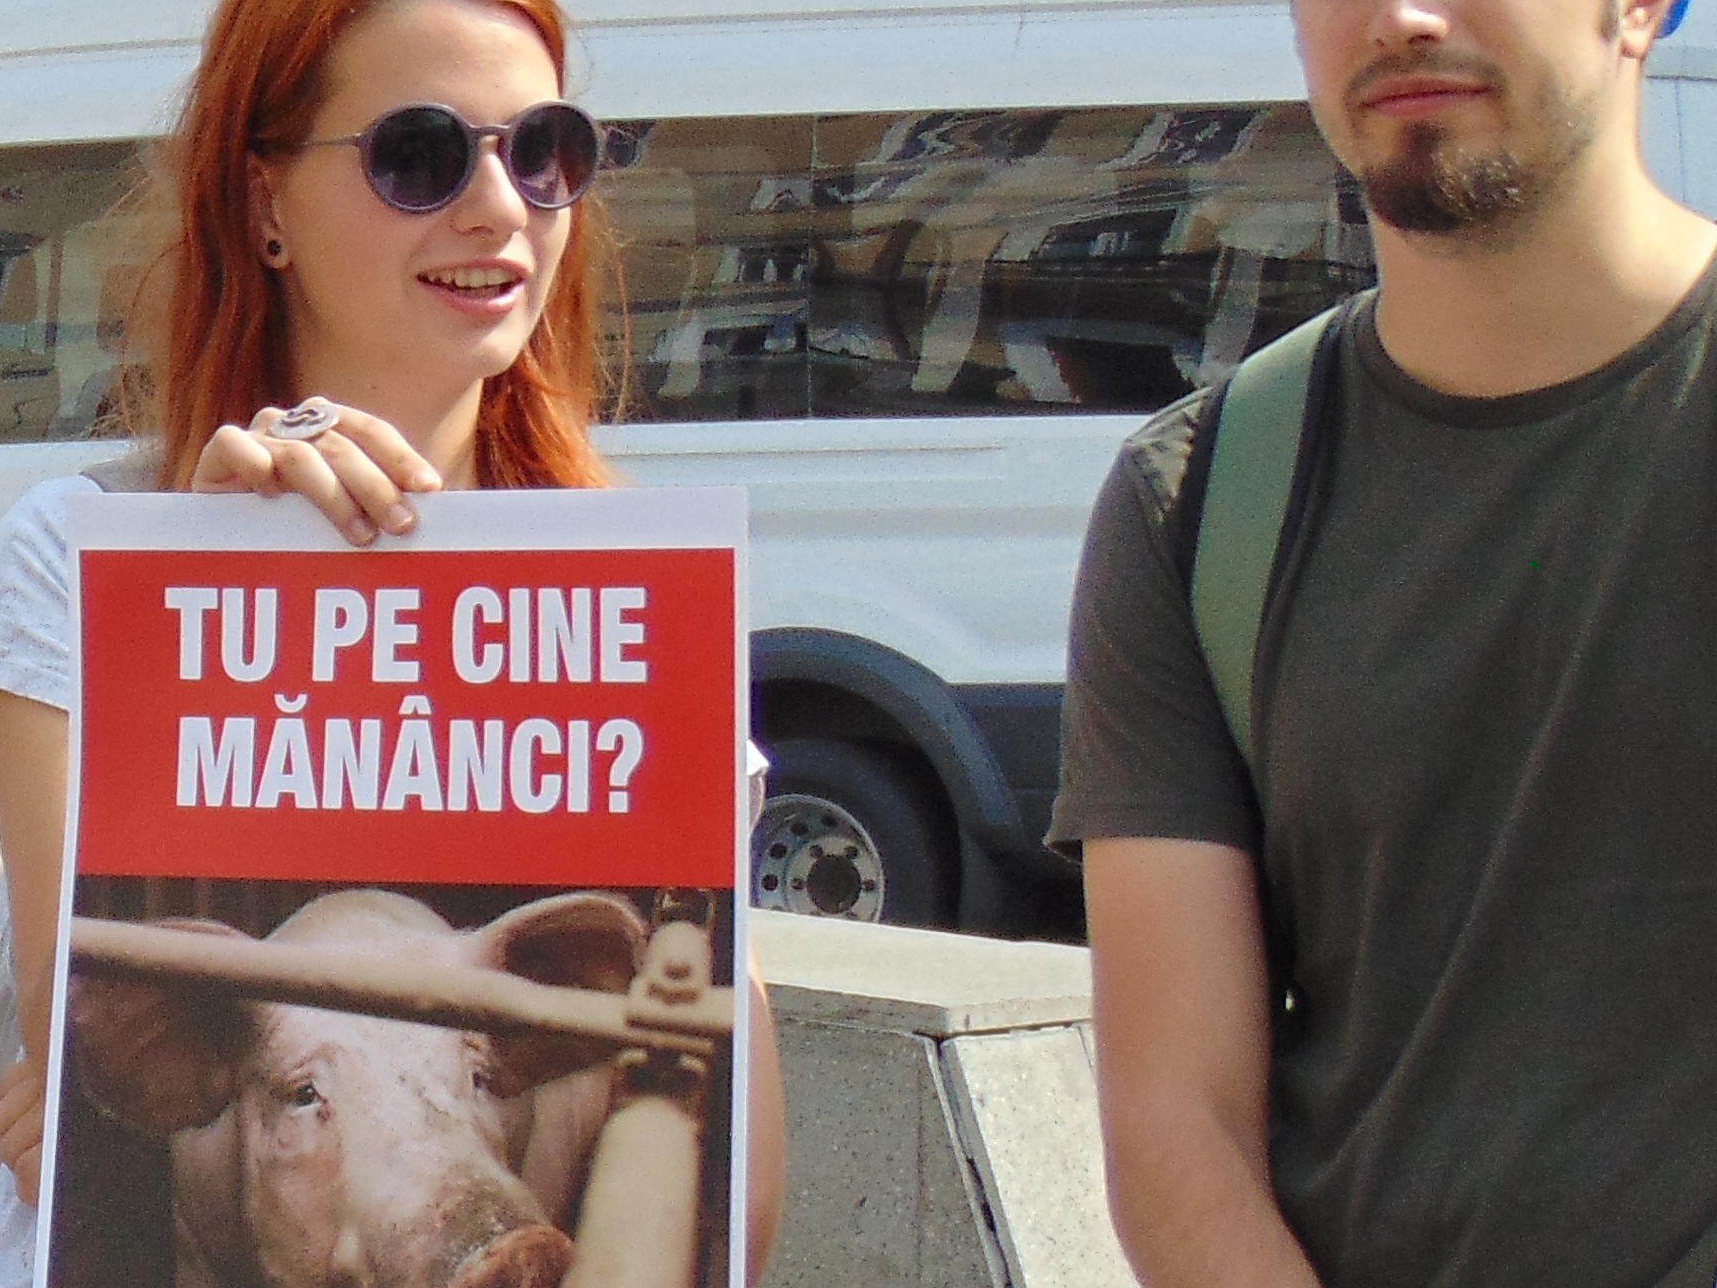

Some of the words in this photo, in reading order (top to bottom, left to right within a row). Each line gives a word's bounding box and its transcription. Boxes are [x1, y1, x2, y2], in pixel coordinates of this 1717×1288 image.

[164, 586, 278, 681] TU
[312, 587, 421, 682] PE
[452, 585, 648, 684] CINE
[175, 693, 643, 814] MĂNÂNCI?
